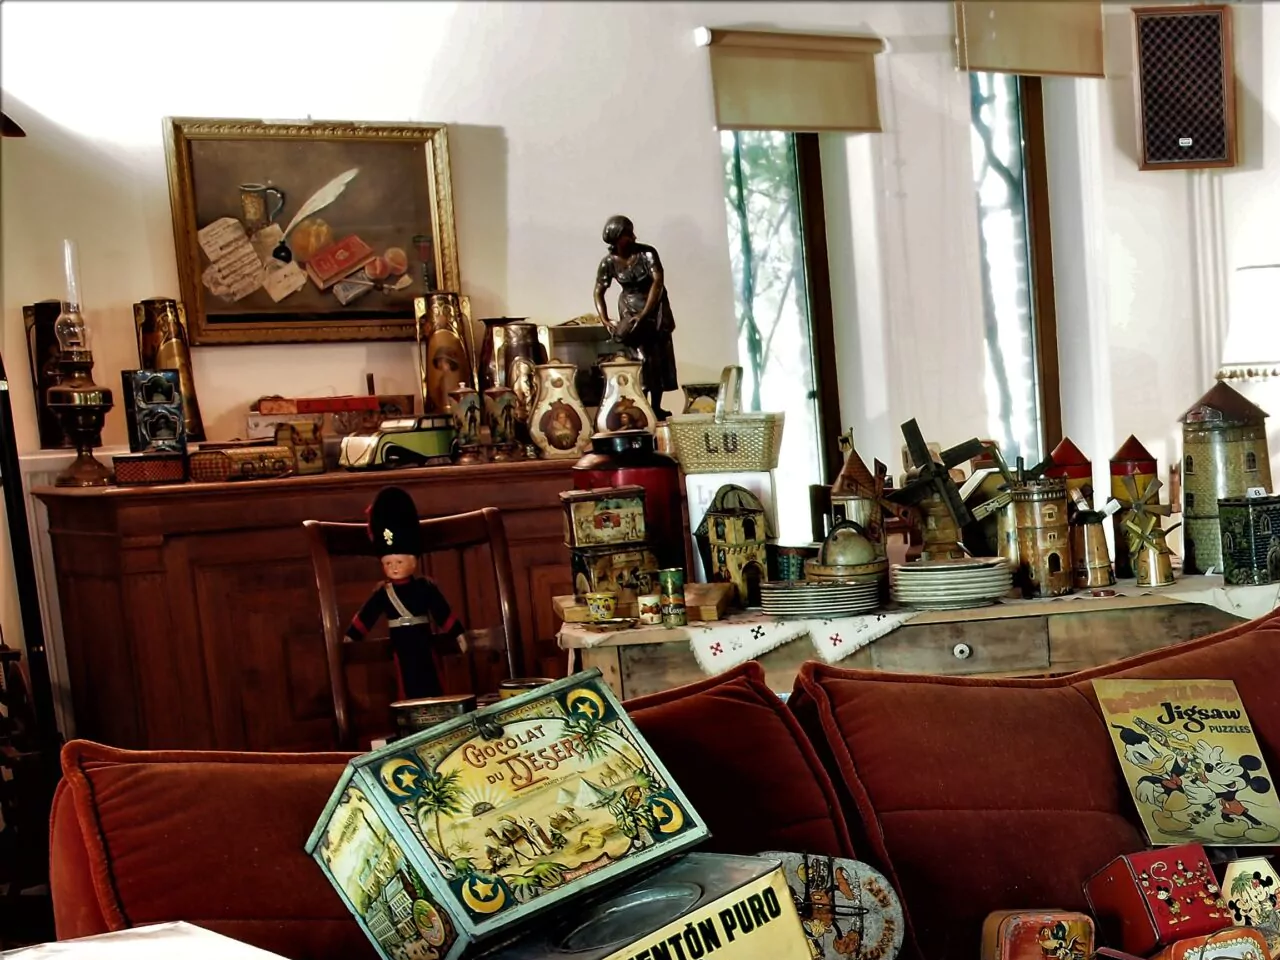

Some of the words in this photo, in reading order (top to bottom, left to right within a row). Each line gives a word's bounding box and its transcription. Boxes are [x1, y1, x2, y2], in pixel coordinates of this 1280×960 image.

[704, 431, 739, 454] LU
[1157, 702, 1241, 733] Jigsaw
[1209, 725, 1251, 734] PUZZLES
[462, 724, 546, 769] CHOCOLAT
[486, 773, 506, 785] DU
[717, 886, 782, 944] PURO
